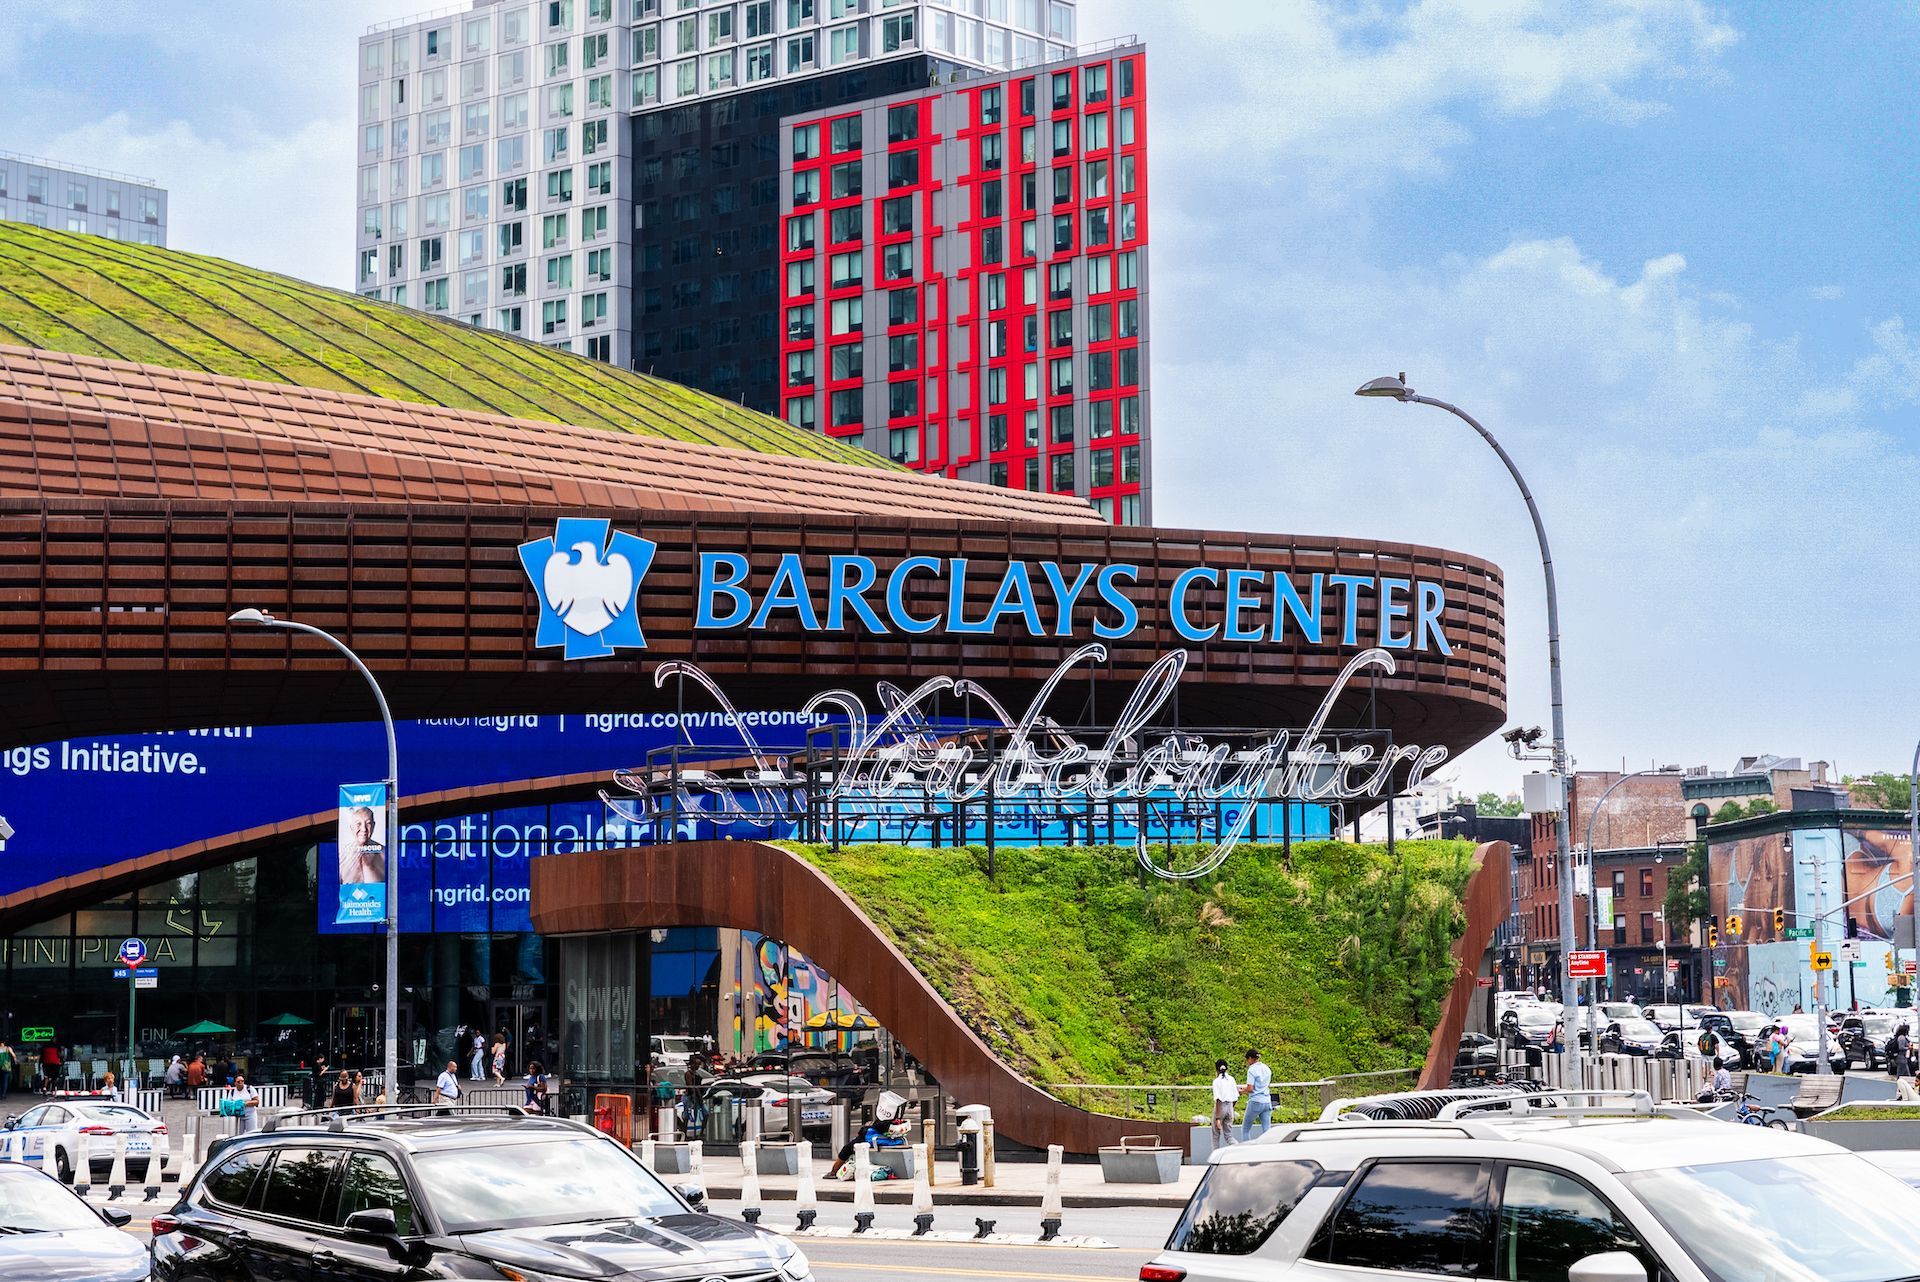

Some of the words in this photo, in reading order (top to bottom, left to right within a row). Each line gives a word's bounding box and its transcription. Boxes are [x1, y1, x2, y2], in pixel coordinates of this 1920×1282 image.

[694, 551, 1139, 639] BARCLAYS
[1169, 566, 1454, 656] CENTER
[1275, 648, 1449, 801] here
[61, 741, 207, 774] Initiative.
[349, 907, 372, 916] Health
[1788, 929, 1807, 937] Pacific
[567, 977, 631, 1030] Subway
